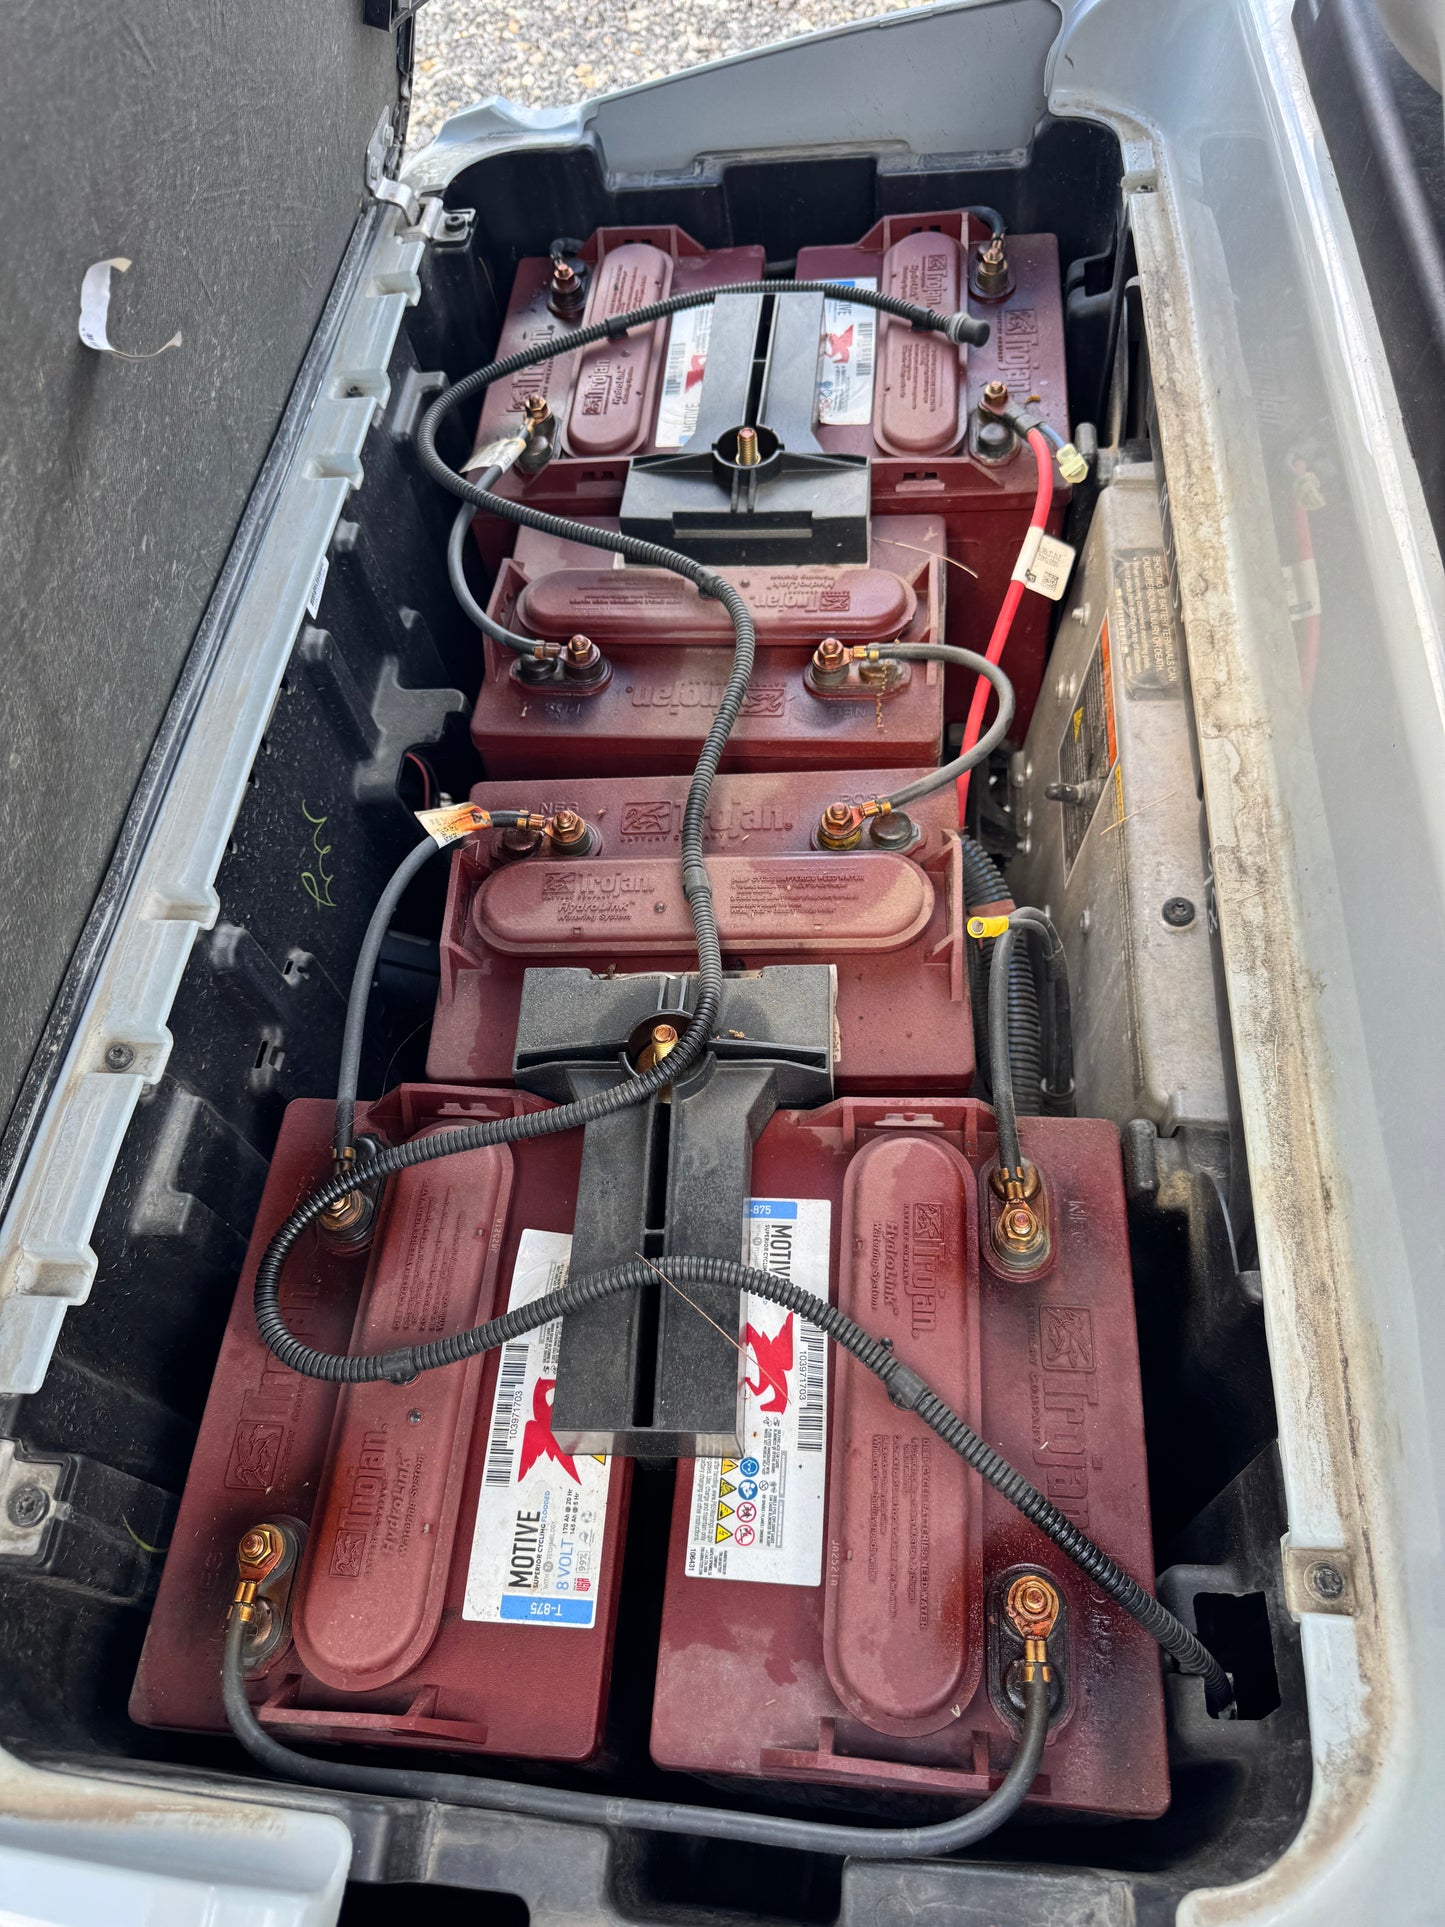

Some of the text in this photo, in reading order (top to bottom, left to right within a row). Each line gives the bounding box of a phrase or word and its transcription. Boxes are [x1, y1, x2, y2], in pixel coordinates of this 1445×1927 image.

[921, 271, 947, 305] Trojan
[994, 334, 1042, 395] Trojan
[1142, 556, 1152, 577] CAUSE
[754, 591, 817, 612] Trojan
[1144, 577, 1156, 610] PERSONAL
[1157, 589, 1165, 597] OF
[1149, 612, 1160, 635] INJURY
[1158, 598, 1169, 627] BATTERY
[1152, 636, 1161, 646] OR
[1162, 629, 1174, 665] TERMINALS
[578, 872, 650, 897] Trojan
[558, 900, 628, 912] HydroLink
[868, 1220, 884, 1310] Watering System
[879, 1219, 903, 1306] HydroLink
[901, 1243, 951, 1331] Trojan
[798, 1349, 807, 1401] 103971703
[507, 1389, 523, 1440] 103971703
[335, 1426, 396, 1535] Trojan
[407, 1453, 425, 1497] System
[377, 1455, 415, 1554] HydroLink
[561, 1488, 573, 1534] 170 Ah @ 20 Hr
[571, 1506, 578, 1514] @
[572, 1491, 579, 1500] Hr
[568, 1523, 576, 1535] 145
[570, 1513, 577, 1523] Ah
[916, 1439, 932, 1630] DEEP CYCLE BATTERIES NEED WATER
[507, 1508, 542, 1589] MOTIVE
[531, 1489, 551, 1589] SUPERIOR CYCLING FLOODED
[555, 1538, 575, 1590] 8 VOLT
[577, 1552, 588, 1572] 99%
[687, 1548, 696, 1571] 106431
[829, 1539, 840, 1585] JA2521A
[574, 1576, 591, 1593] USA
[529, 1601, 563, 1617] T-875
